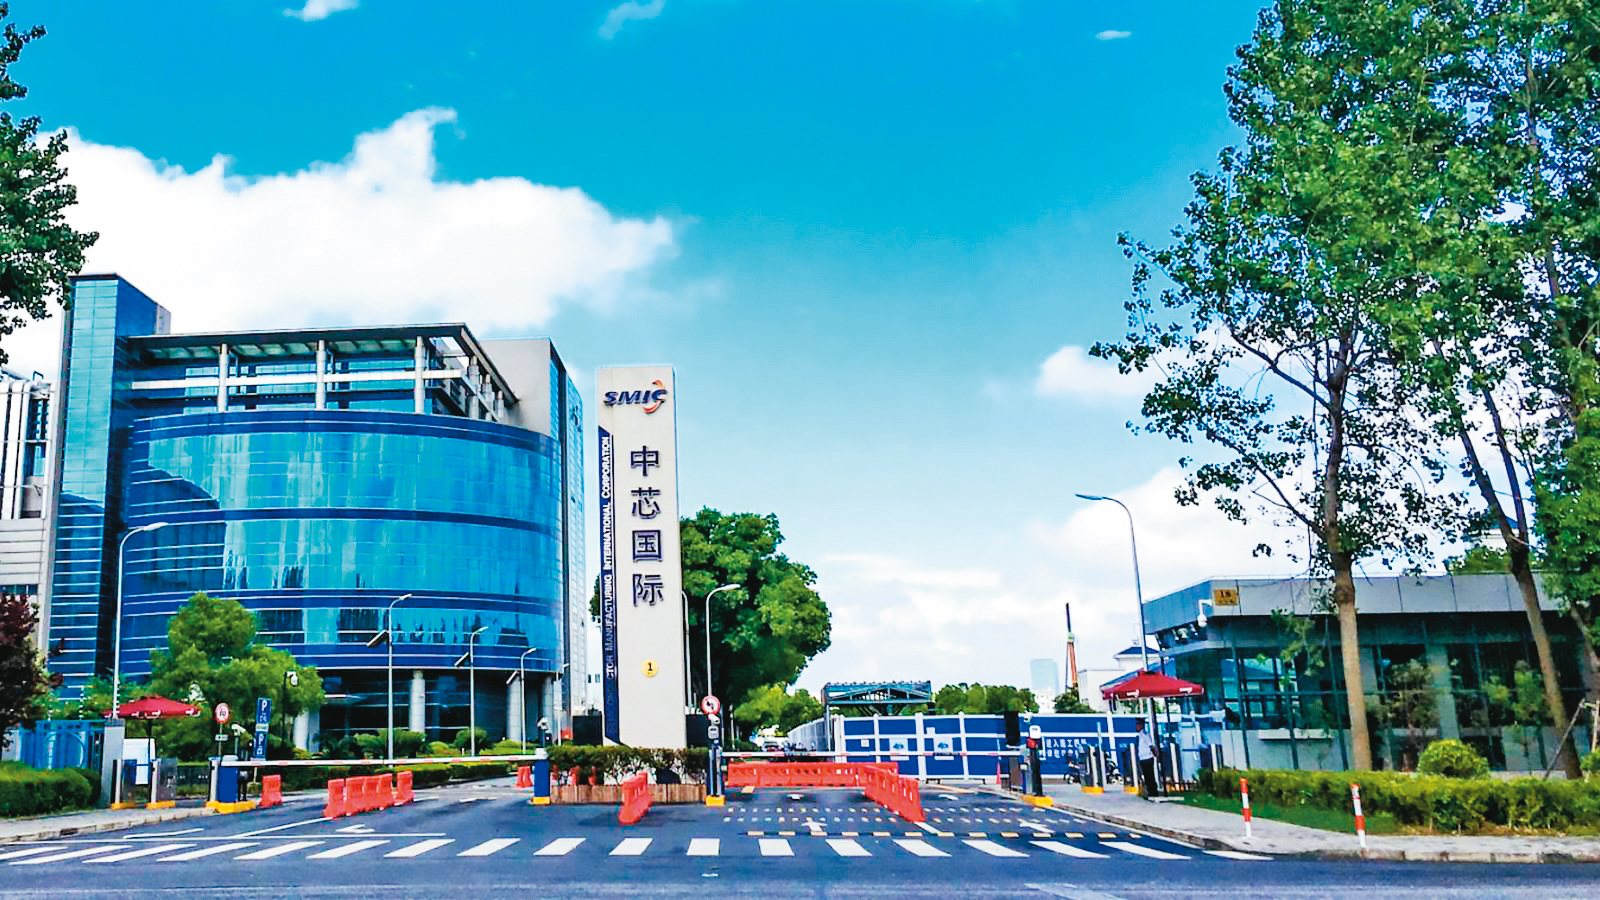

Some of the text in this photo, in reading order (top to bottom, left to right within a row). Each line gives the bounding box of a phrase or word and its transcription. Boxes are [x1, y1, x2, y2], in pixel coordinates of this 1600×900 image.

[603, 389, 668, 407] SMIC
[601, 436, 610, 499] CORPORATION
[603, 502, 612, 570] INTERNATIONAL
[630, 445, 664, 608] 中芯国际
[604, 574, 613, 651] MANUFACTURING
[647, 661, 654, 671] 1
[261, 700, 268, 712] P
[258, 733, 265, 745] P
